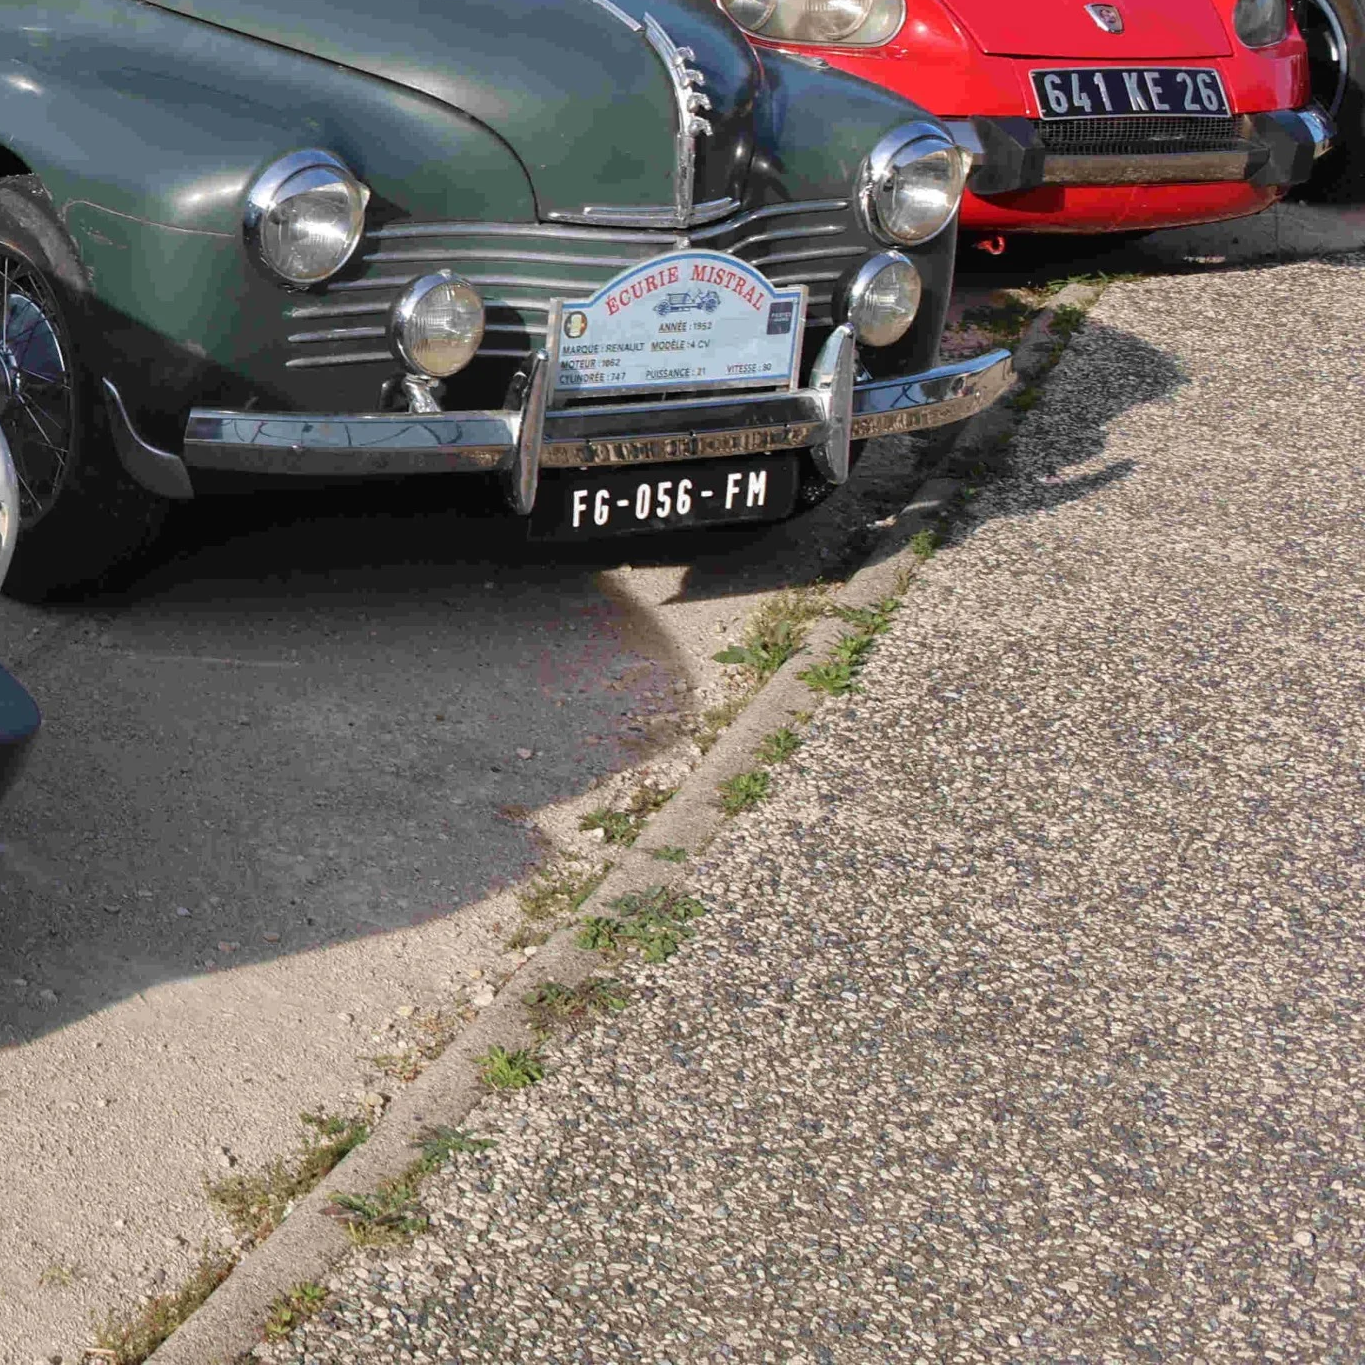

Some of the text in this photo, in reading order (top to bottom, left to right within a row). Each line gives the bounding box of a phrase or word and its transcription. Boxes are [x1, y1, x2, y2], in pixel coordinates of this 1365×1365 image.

[1044, 71, 1219, 114] 641 KE 26
[690, 265, 765, 311] MISTRAL
[562, 344, 599, 355] MARQUE
[605, 343, 645, 353] RENAULT
[698, 339, 710, 348] CV
[560, 359, 596, 370] MOTEUR
[645, 368, 690, 380] PUISSANCE
[726, 363, 756, 374] VITESSE
[572, 470, 768, 527] FG-056-FM
